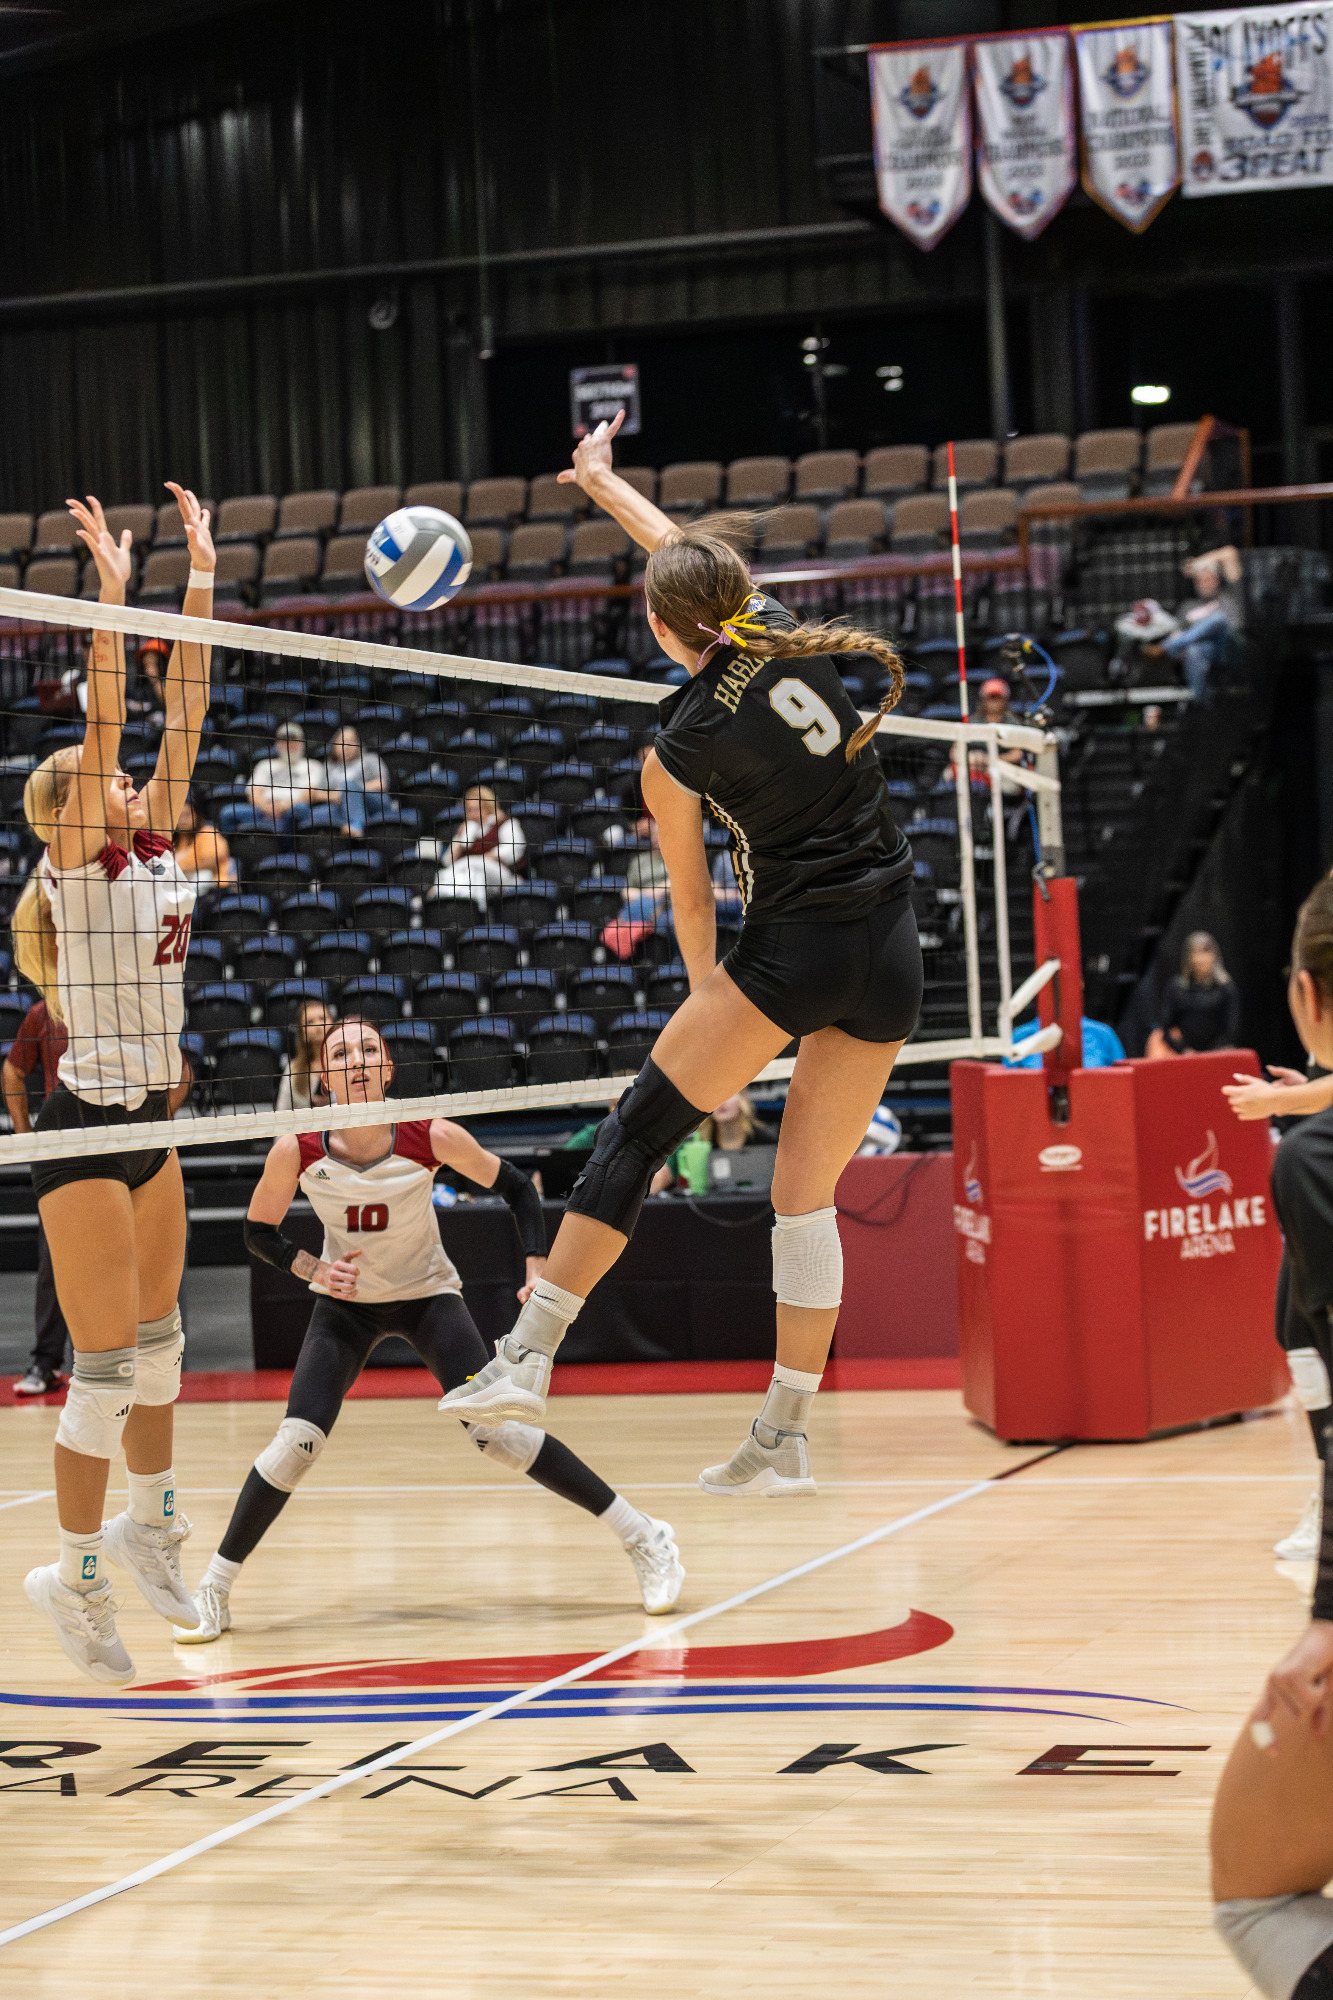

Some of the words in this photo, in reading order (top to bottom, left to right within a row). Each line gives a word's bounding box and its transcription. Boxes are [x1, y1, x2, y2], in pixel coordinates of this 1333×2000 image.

[769, 678, 841, 757] 9
[153, 914, 192, 966] 20
[344, 1203, 389, 1233] 10
[1144, 1196, 1266, 1241] FIRELAKE
[1180, 1232, 1235, 1260] ARENA
